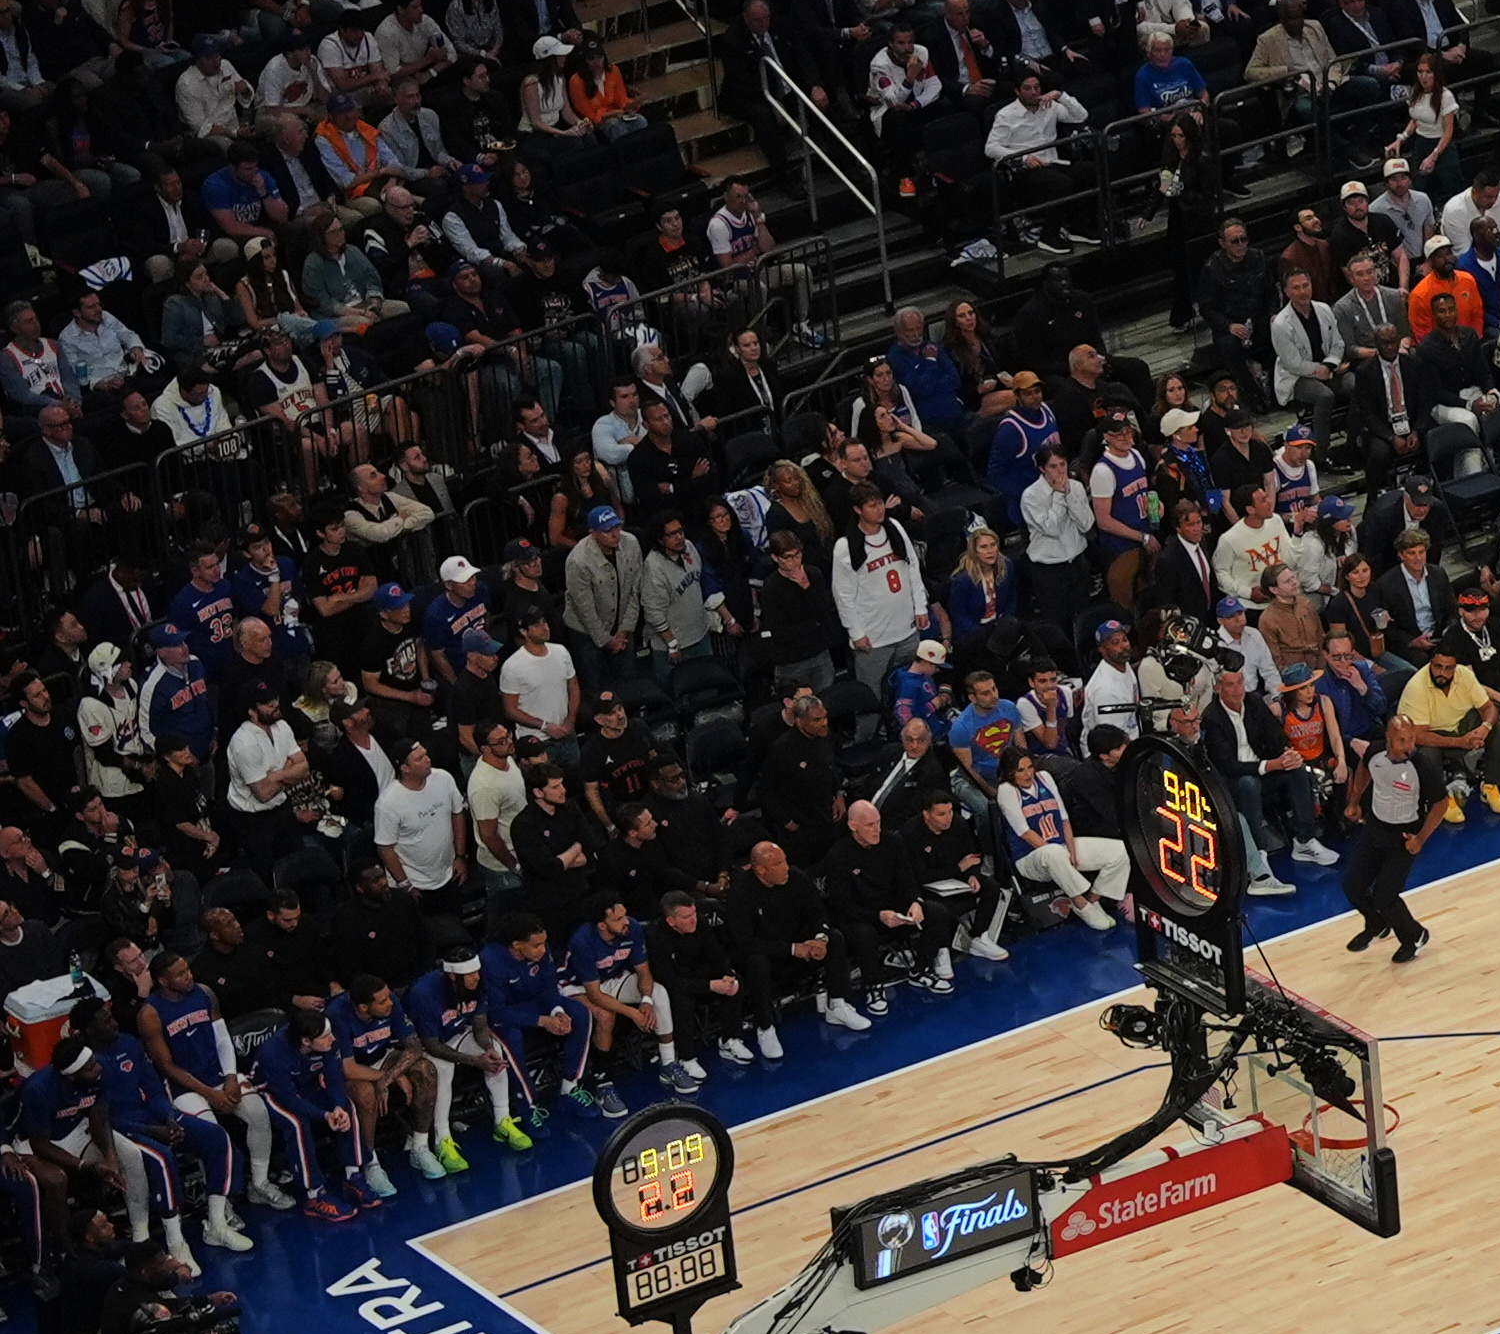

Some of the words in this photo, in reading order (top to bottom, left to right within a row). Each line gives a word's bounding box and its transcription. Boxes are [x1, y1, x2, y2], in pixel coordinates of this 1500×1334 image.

[217, 439, 239, 457] 108
[1156, 803, 1218, 901] 22
[1160, 917, 1224, 967] TISSOT
[656, 1226, 728, 1263] TISSOT
[942, 1189, 1028, 1259] Finals
